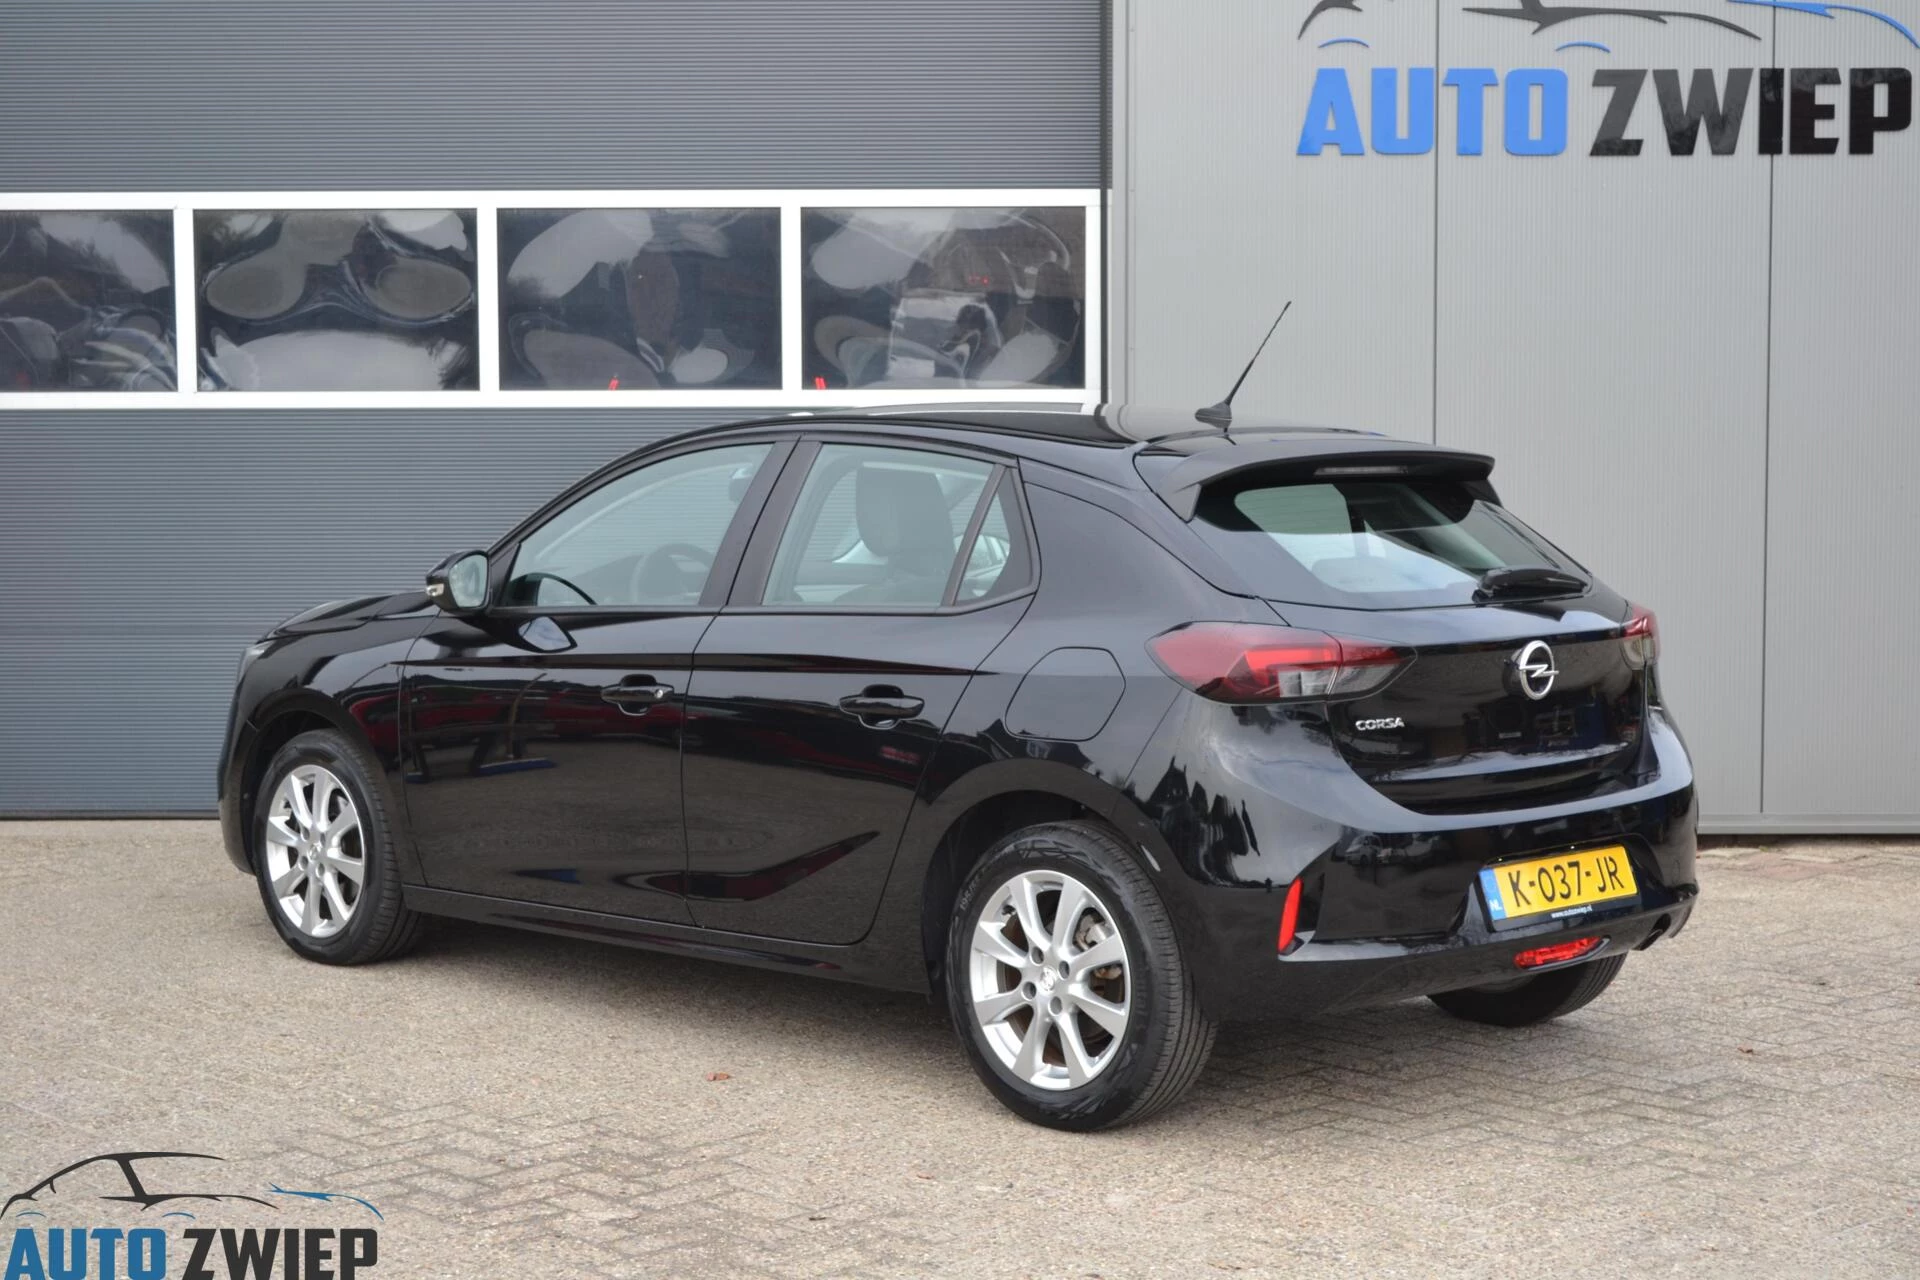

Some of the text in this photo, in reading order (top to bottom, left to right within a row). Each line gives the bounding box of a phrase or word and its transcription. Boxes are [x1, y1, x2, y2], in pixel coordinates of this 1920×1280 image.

[1296, 67, 1912, 156] AUTO ZWIEP
[1355, 717, 1405, 731] CORSA
[1508, 856, 1625, 907] K-037-JR
[1489, 899, 1503, 912] NL
